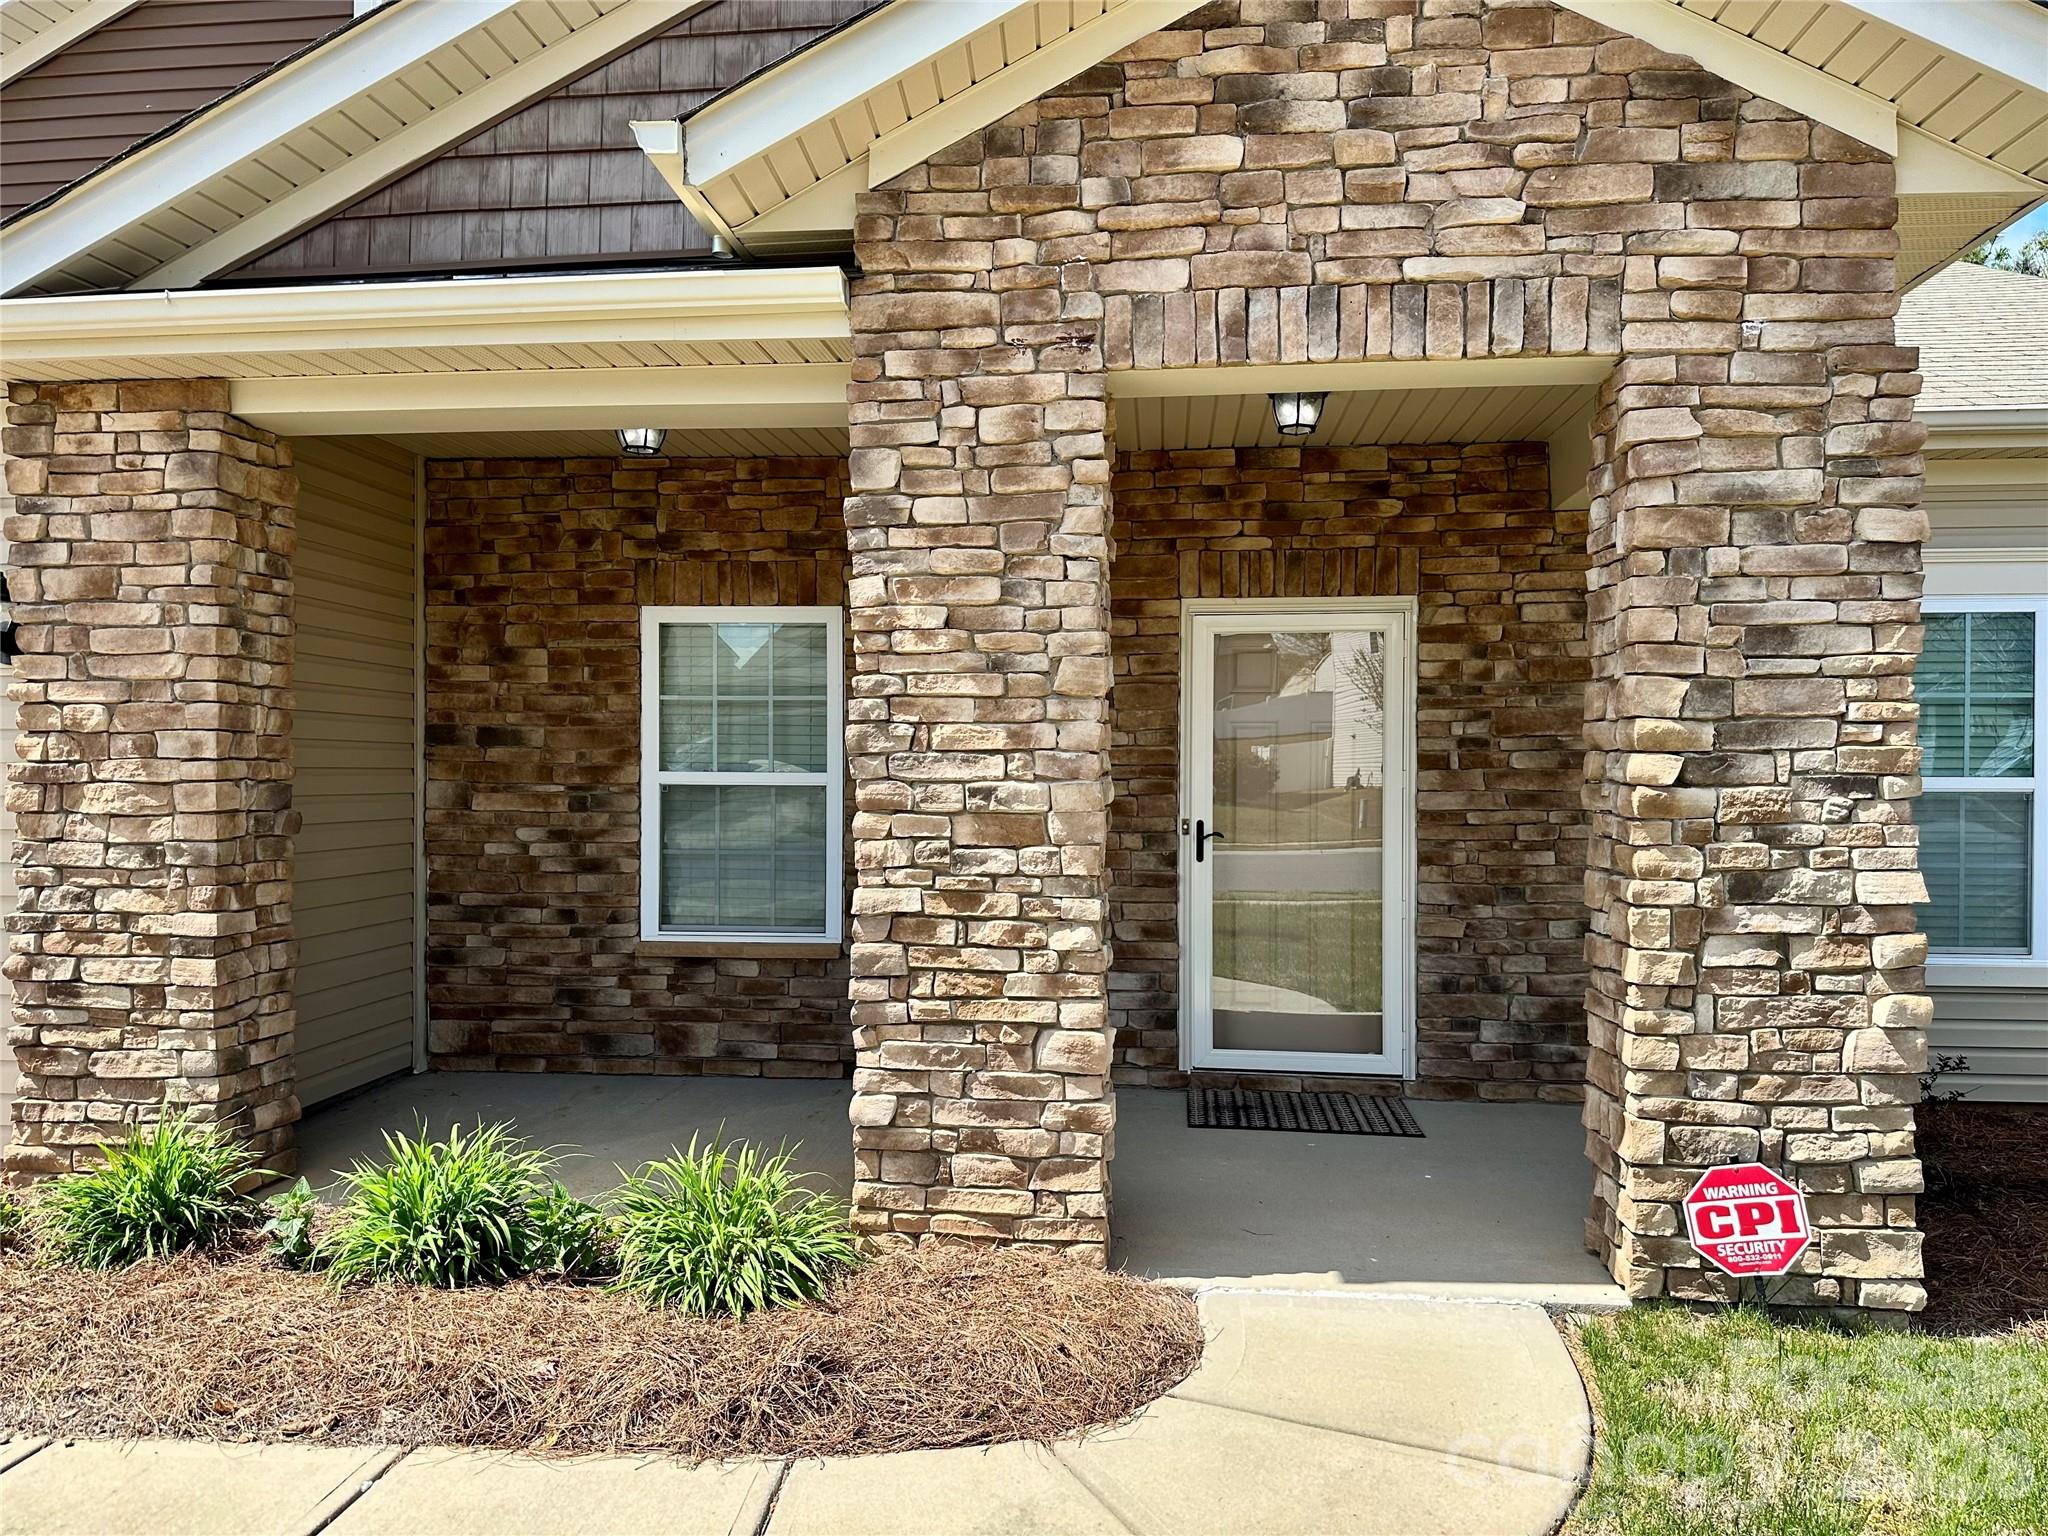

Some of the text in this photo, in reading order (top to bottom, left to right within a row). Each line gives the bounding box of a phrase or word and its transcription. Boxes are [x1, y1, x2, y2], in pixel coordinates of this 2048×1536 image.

[1703, 1182, 1778, 1200] WARNING
[1695, 1199, 1801, 1240] CPI
[1716, 1240, 1786, 1258] SECURITY
[1727, 1253, 1782, 1263] 800-532-0911
